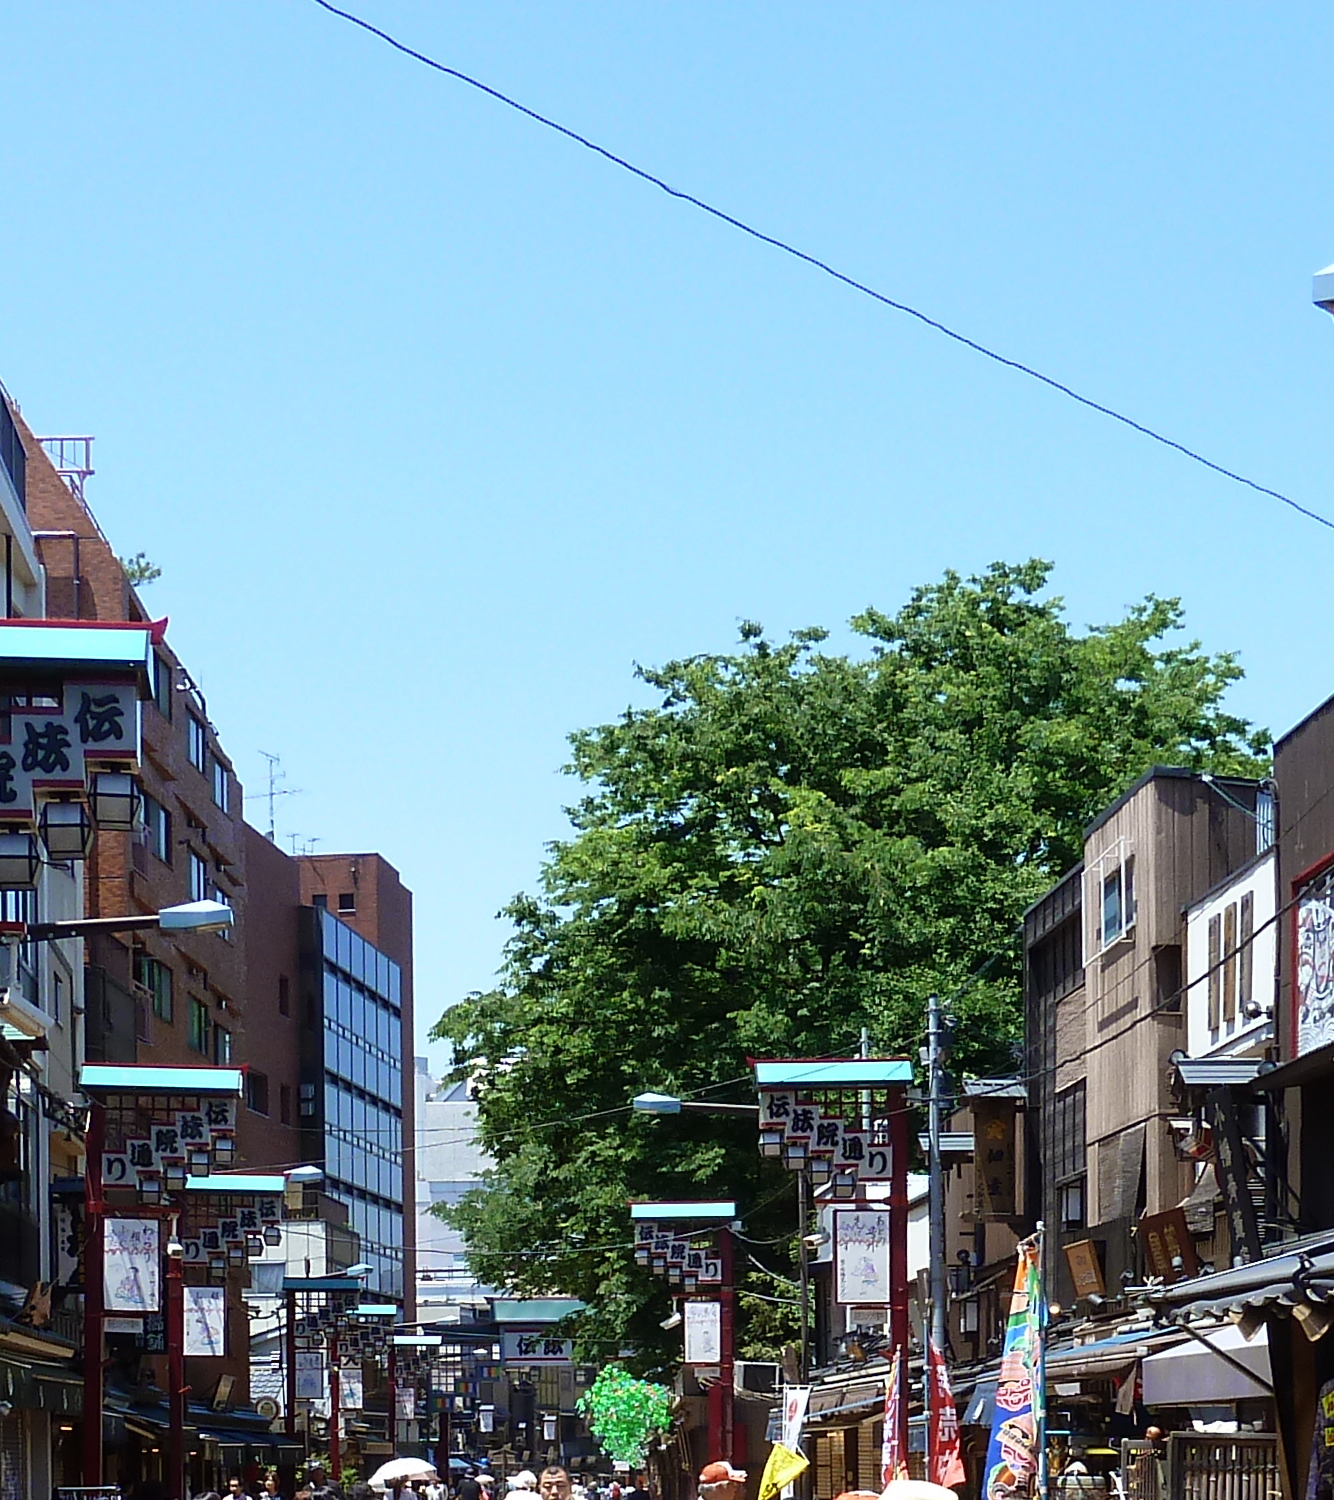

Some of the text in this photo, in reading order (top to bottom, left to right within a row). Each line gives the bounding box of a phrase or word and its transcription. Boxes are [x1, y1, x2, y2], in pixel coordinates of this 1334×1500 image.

[106, 1100, 229, 1181] 伝法院通り
[767, 1094, 887, 1175] 伝法院通り
[184, 1200, 278, 1259] 伝法院通り
